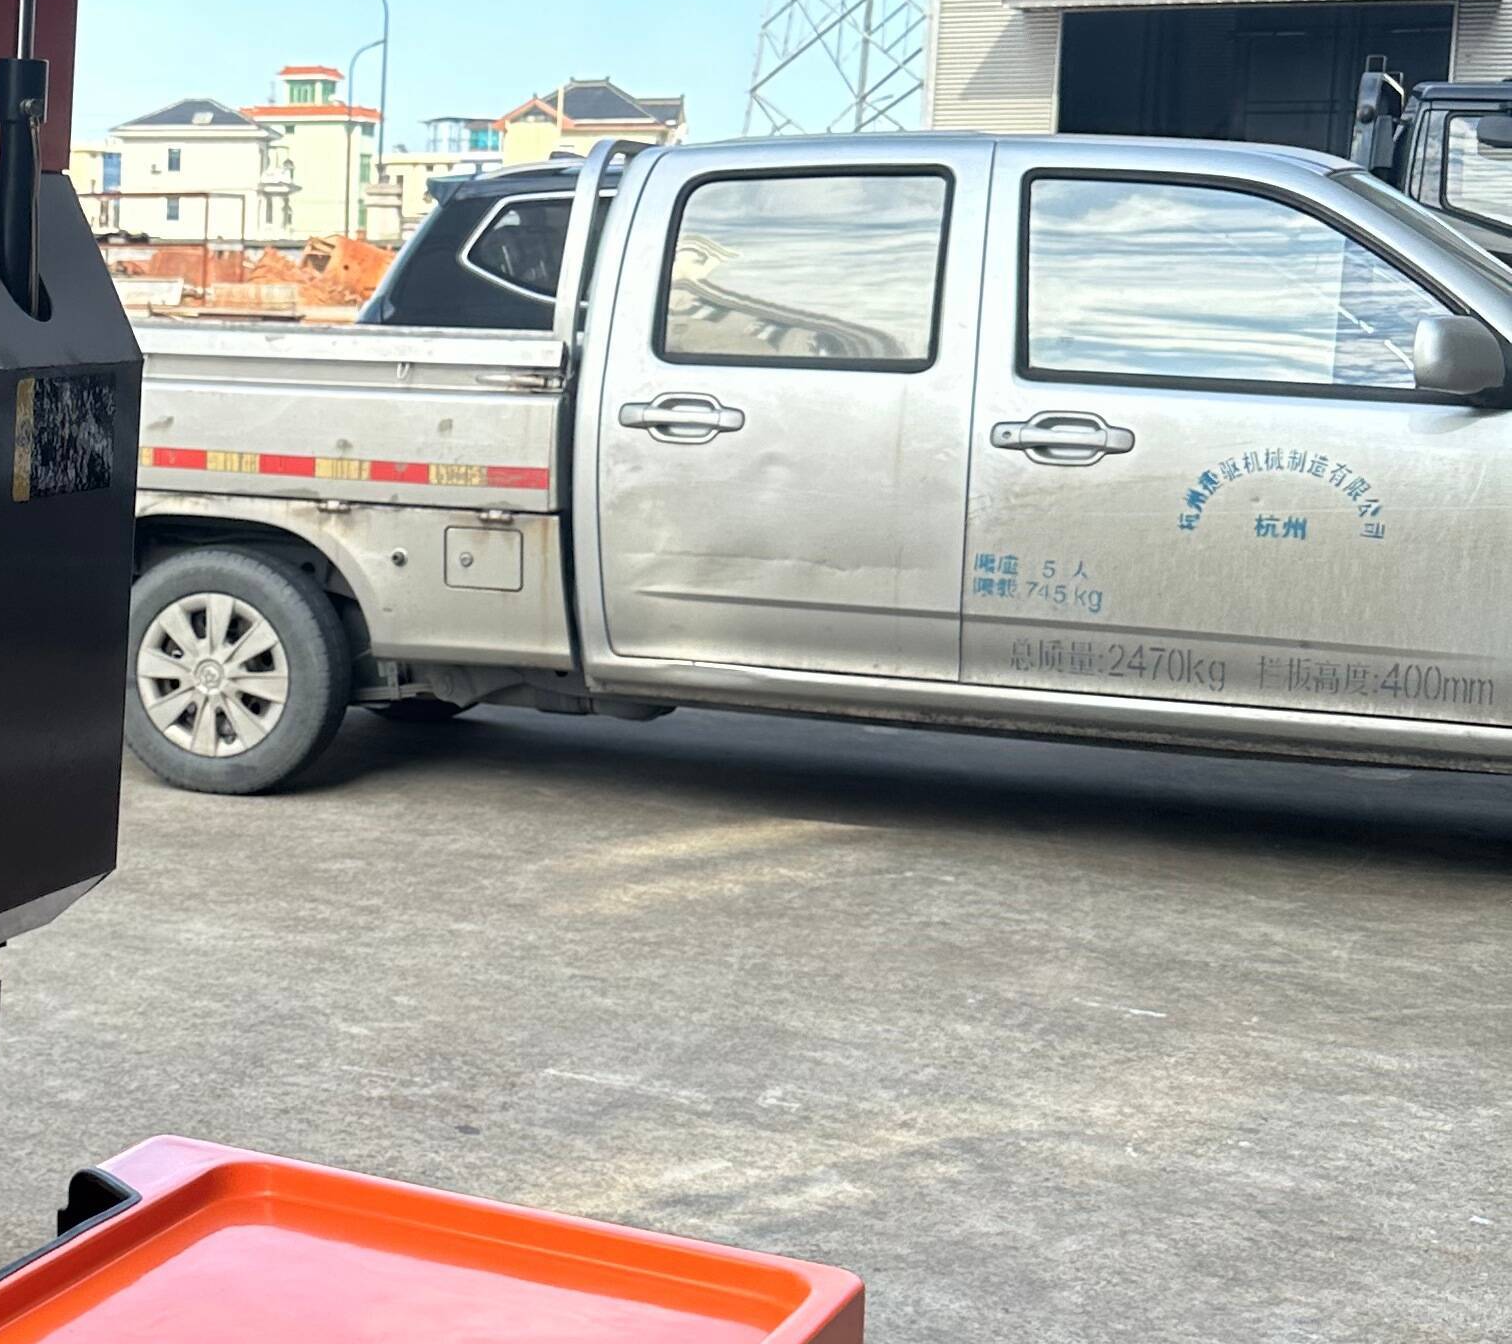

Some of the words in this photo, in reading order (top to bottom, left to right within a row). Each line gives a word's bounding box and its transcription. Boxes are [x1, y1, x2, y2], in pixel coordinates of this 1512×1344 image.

[1254, 513, 1308, 540] 杭州
[1042, 560, 1057, 579] 5
[1072, 560, 1088, 579] 人
